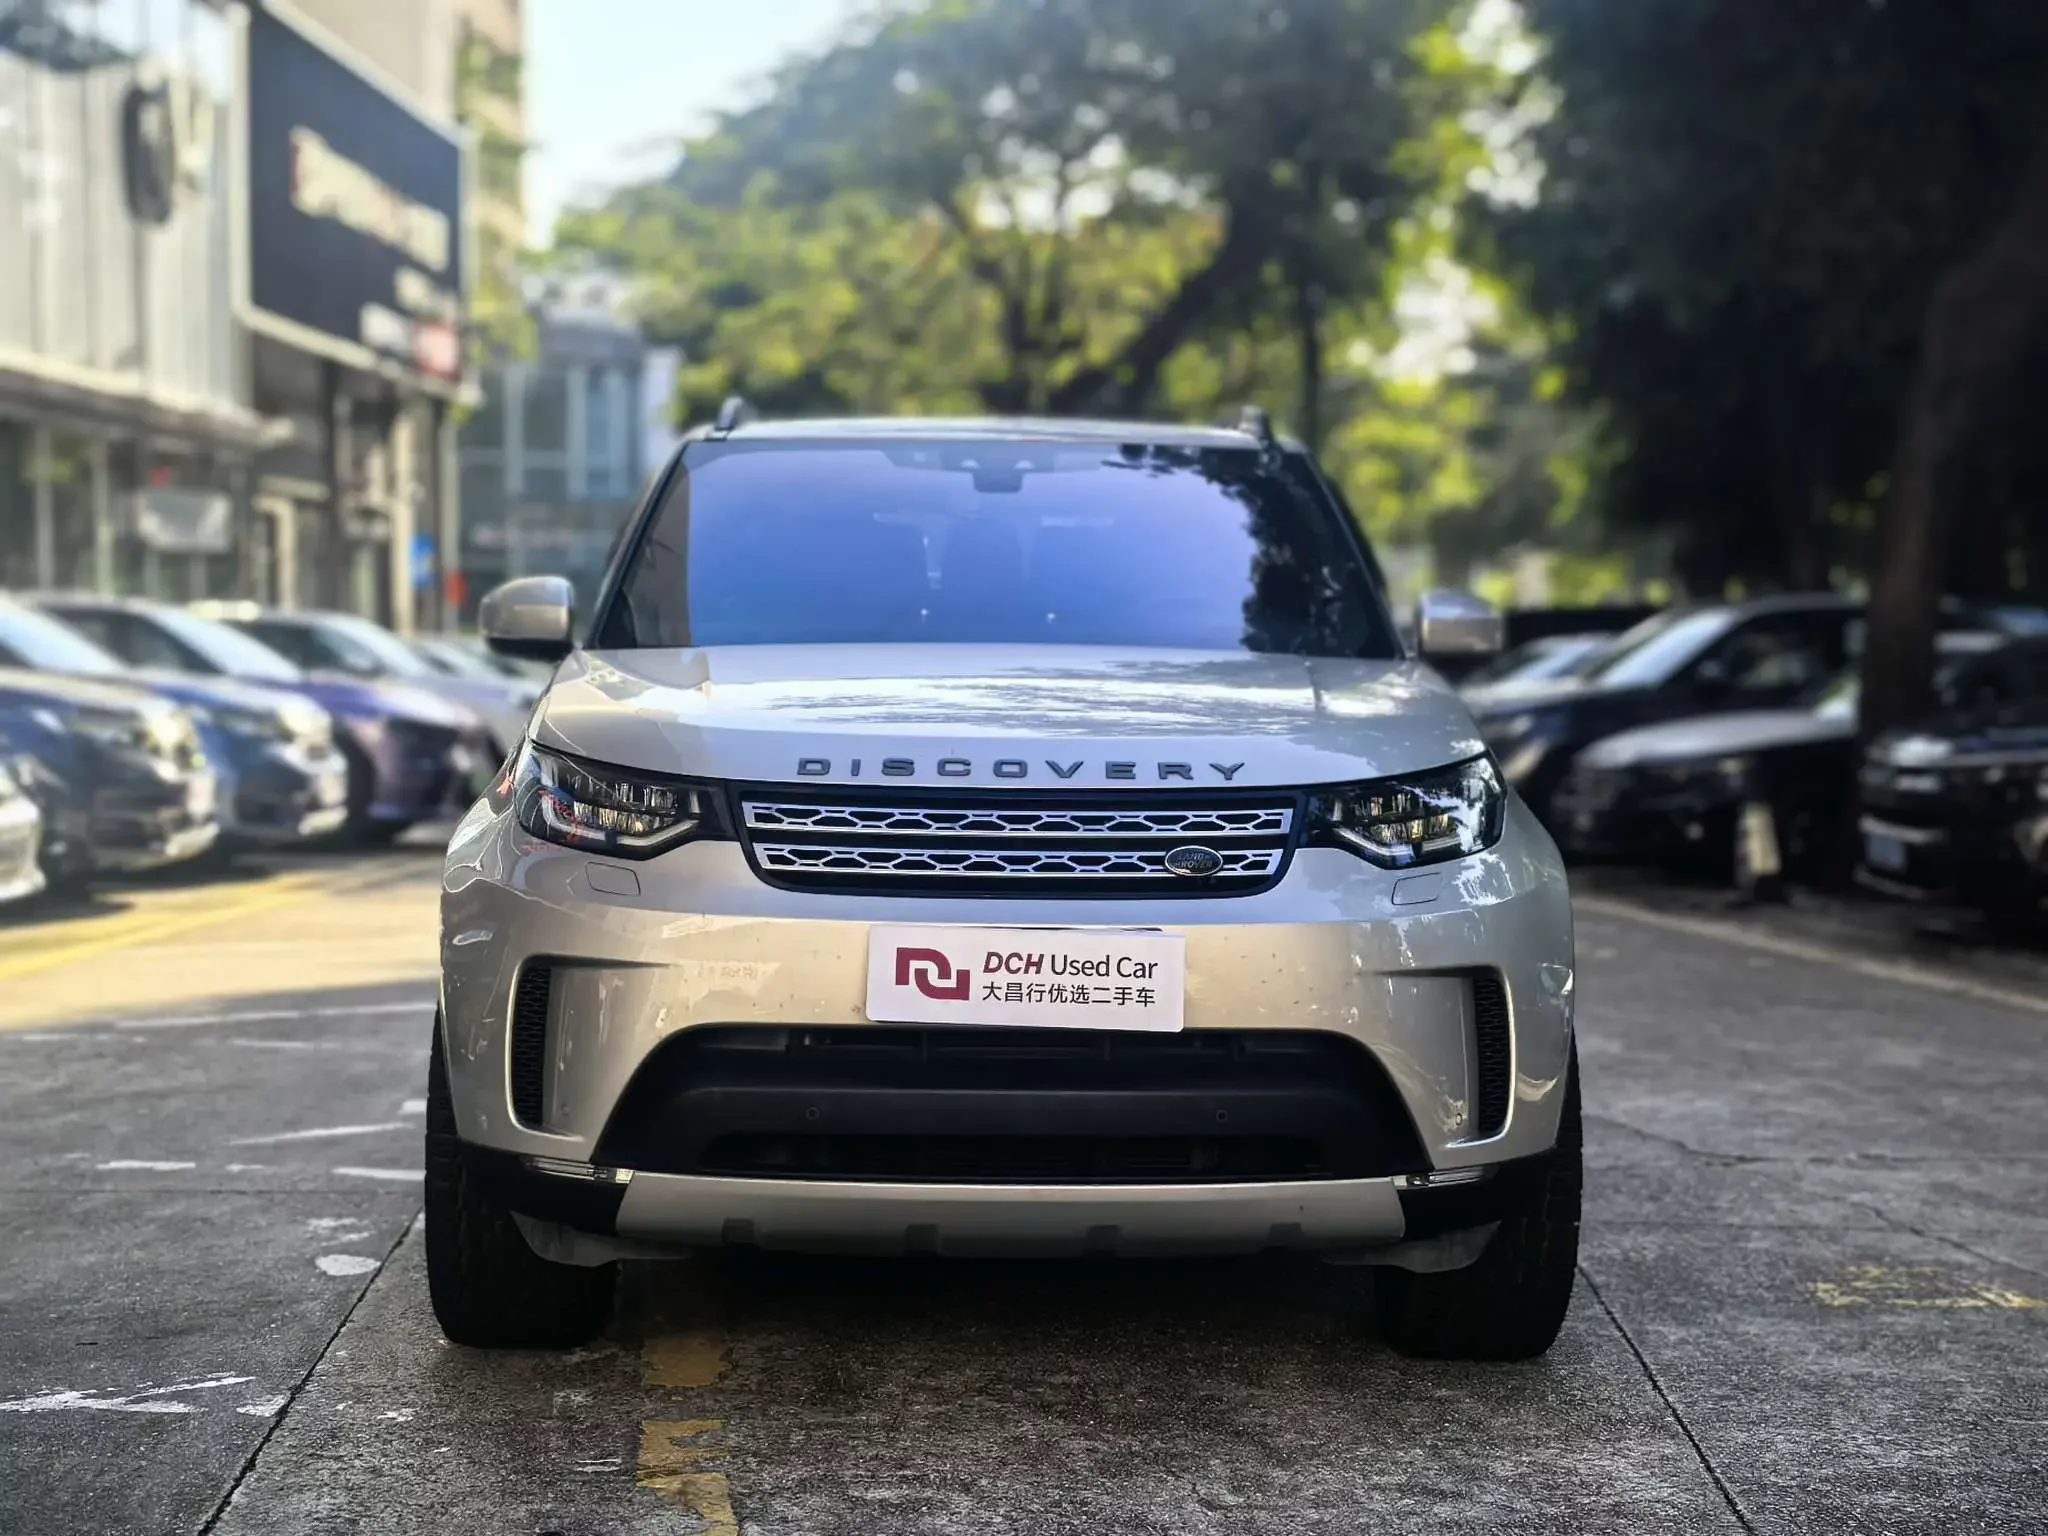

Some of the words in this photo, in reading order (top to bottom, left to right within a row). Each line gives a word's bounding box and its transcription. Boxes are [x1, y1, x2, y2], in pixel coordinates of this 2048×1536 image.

[797, 757, 1245, 781] DISCOVERY
[982, 951, 1045, 975] DCH
[1050, 954, 1111, 977] Used
[1115, 956, 1159, 979] Car
[981, 981, 1156, 1007] 大昌行优选二手车
